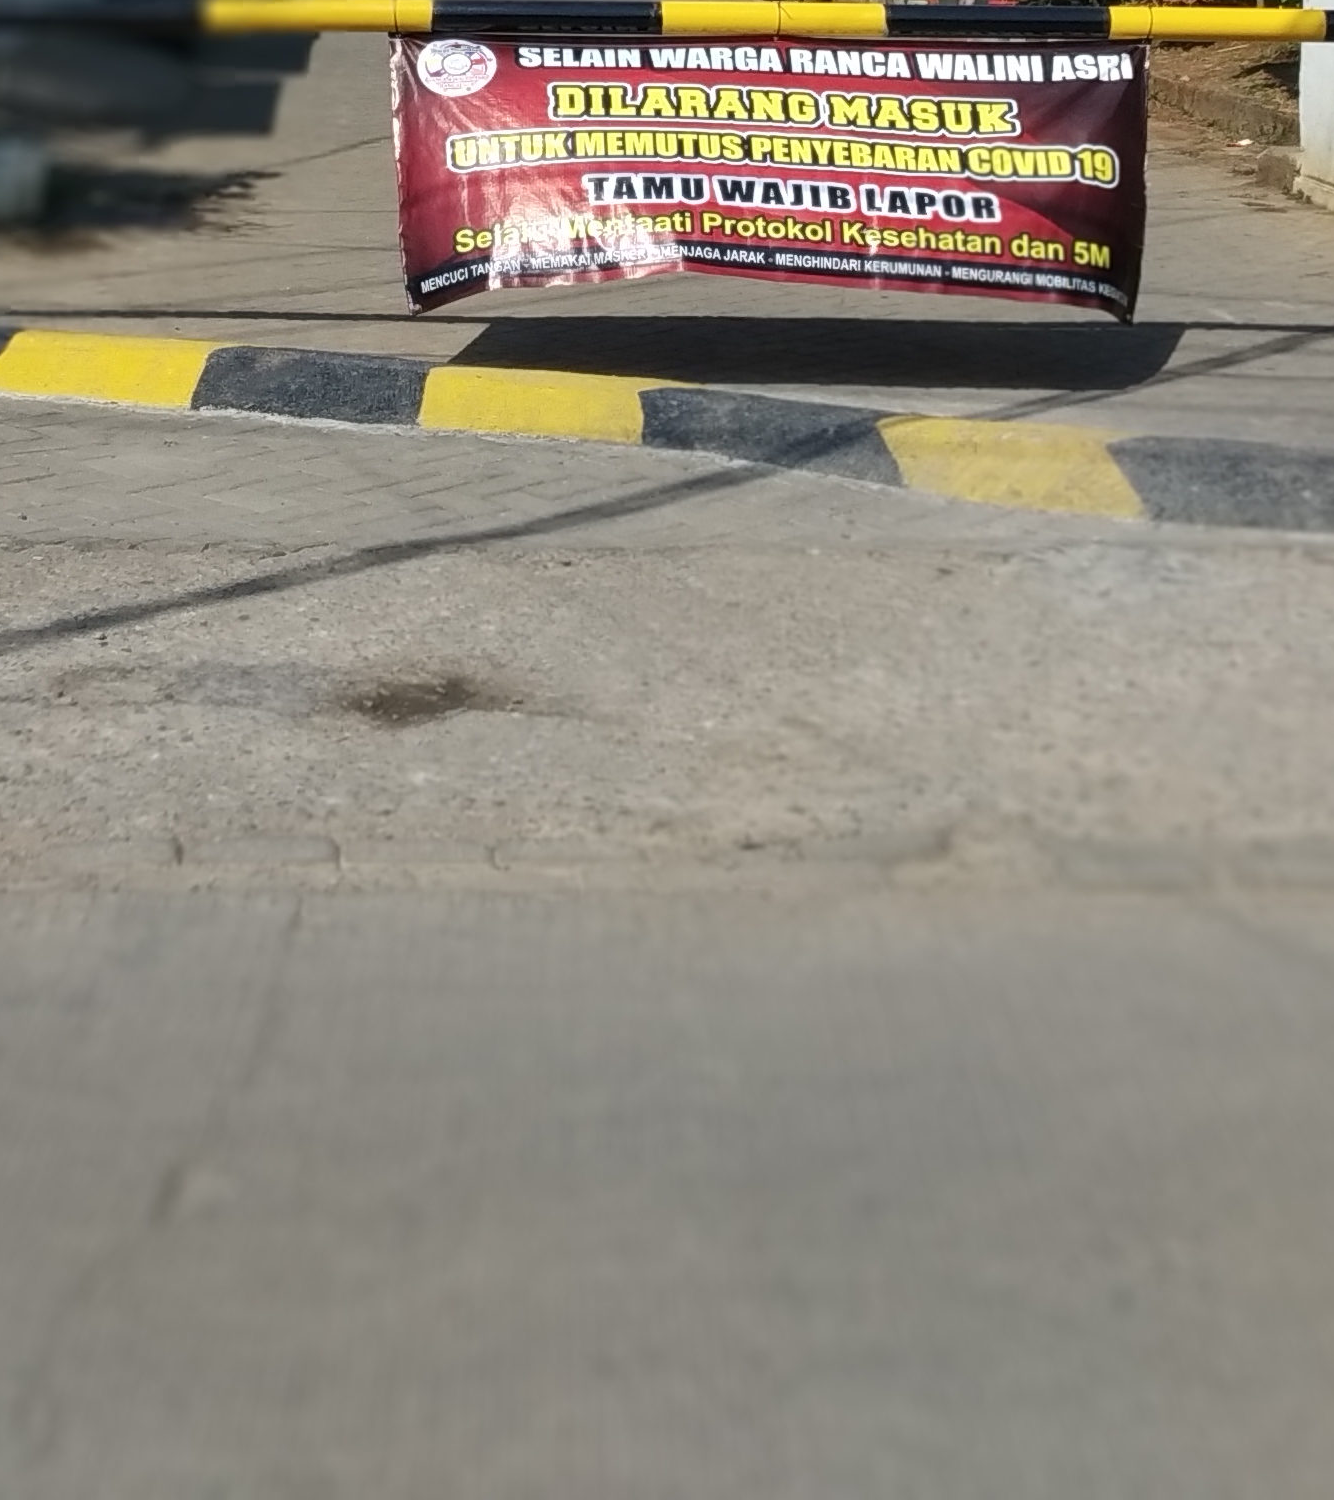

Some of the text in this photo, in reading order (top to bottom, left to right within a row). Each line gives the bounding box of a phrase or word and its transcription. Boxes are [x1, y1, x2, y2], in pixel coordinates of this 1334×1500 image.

[519, 46, 1133, 82] SELAIN WARGA RANCA WALINI ASRI
[556, 85, 1014, 133] DILARANG MASUK
[454, 131, 1114, 182] UNTUK MEMUTUS PENYEBARAN COVID 19
[588, 176, 996, 220] TAMU WAJIB LAPOR
[703, 213, 832, 243] Protokol
[843, 221, 1002, 255] Kesehatan
[1011, 234, 1064, 261] dan
[1074, 241, 1110, 269] 5M
[421, 267, 468, 293] MENCUCI
[470, 258, 521, 280] TANGAN
[532, 255, 591, 272] MEMAKAI
[593, 249, 646, 267] MASKER
[660, 244, 721, 261] MENJAGA
[724, 250, 766, 265] JARAK
[776, 253, 861, 272] MENGHINDARI
[865, 260, 942, 278] KERUMUNAN
[952, 266, 1033, 286] MENGURANGI
[1035, 274, 1096, 293] MOBILITAS
